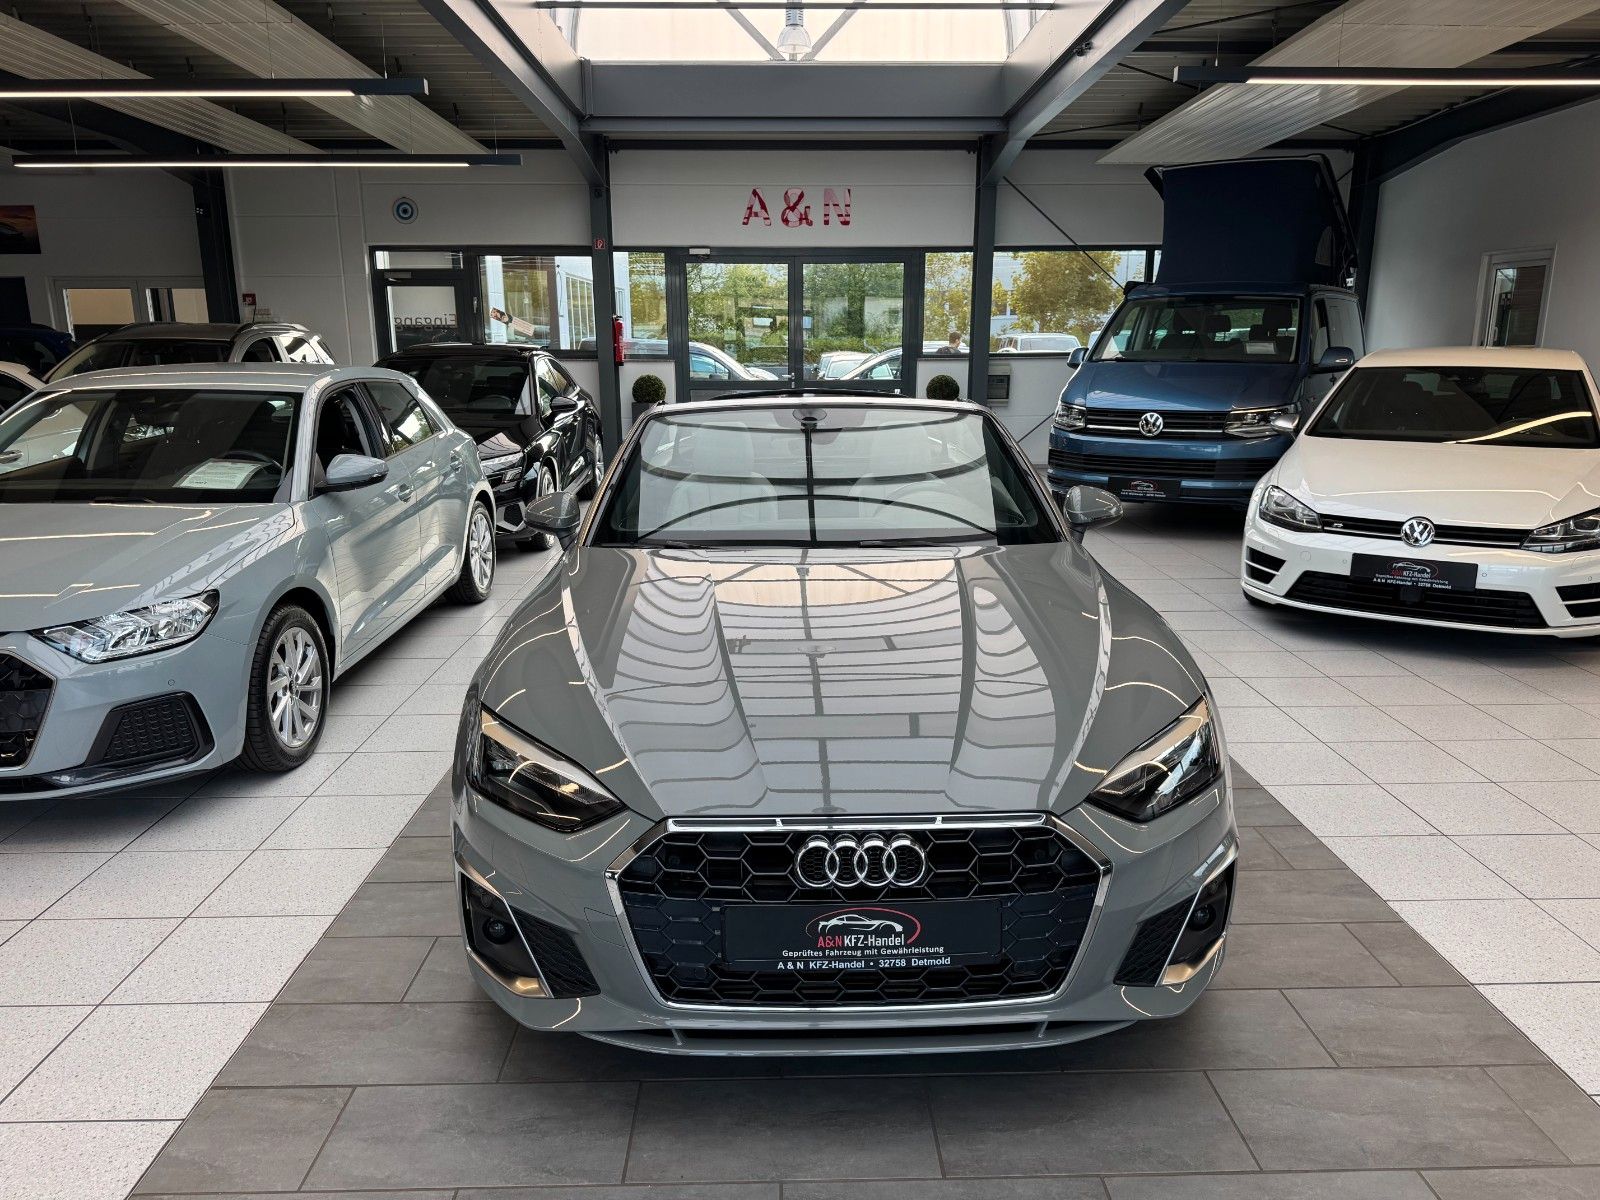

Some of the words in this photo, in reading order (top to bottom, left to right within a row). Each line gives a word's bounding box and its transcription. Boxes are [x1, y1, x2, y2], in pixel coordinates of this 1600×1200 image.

[817, 935, 842, 948] A&N
[844, 933, 905, 947] KFZ-Handel
[782, 949, 823, 958] Geprüftes
[864, 948, 878, 956] mit
[880, 946, 944, 955] Gewährleistung
[809, 960, 865, 969] KFZ-Handel
[878, 958, 907, 968] 32758
[911, 957, 951, 966] Detmold
